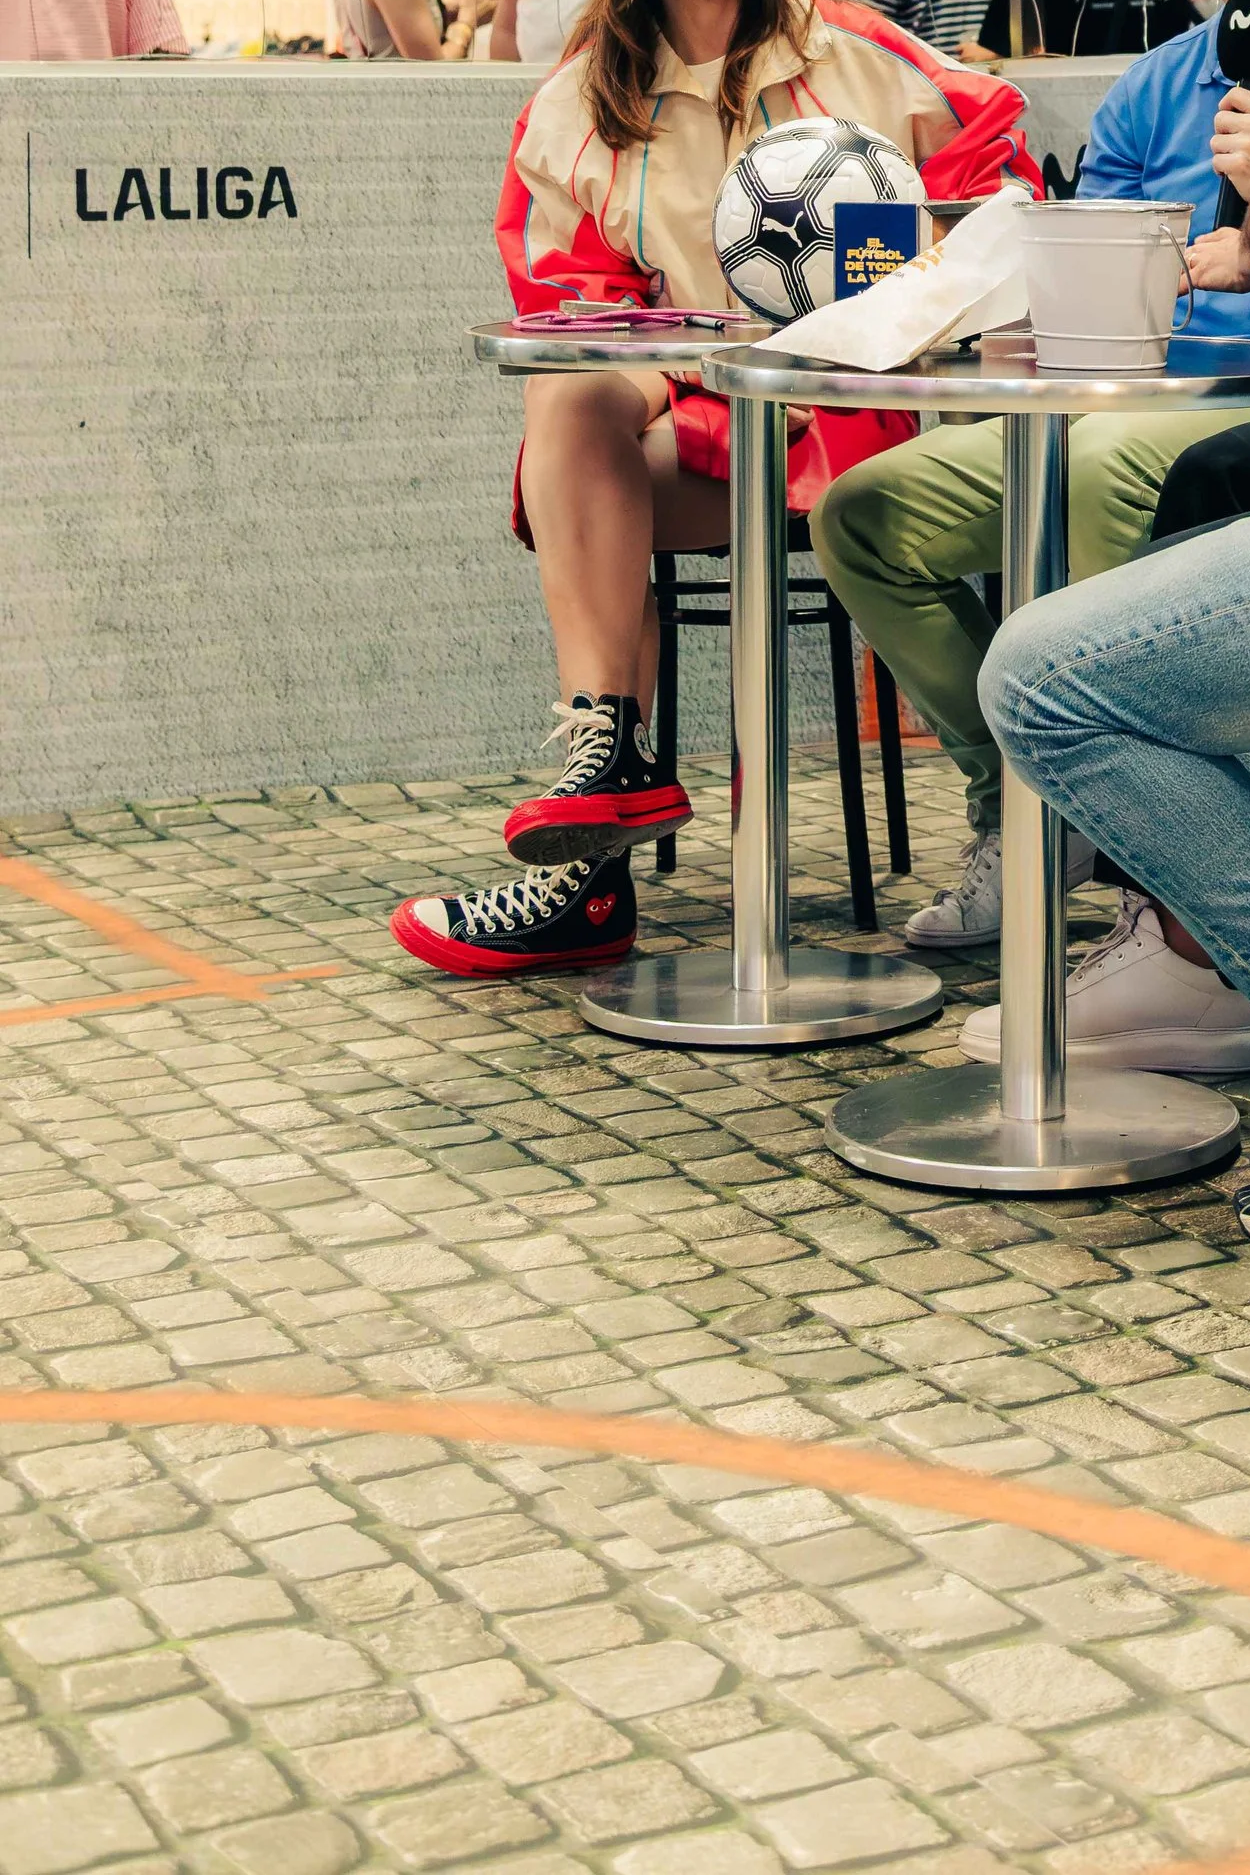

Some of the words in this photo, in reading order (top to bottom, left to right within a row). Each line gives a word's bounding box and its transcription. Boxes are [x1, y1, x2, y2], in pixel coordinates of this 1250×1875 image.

[75, 166, 298, 221] LALIGA
[866, 237, 884, 248] EL
[844, 261, 865, 272] DE
[847, 272, 868, 284] LA
